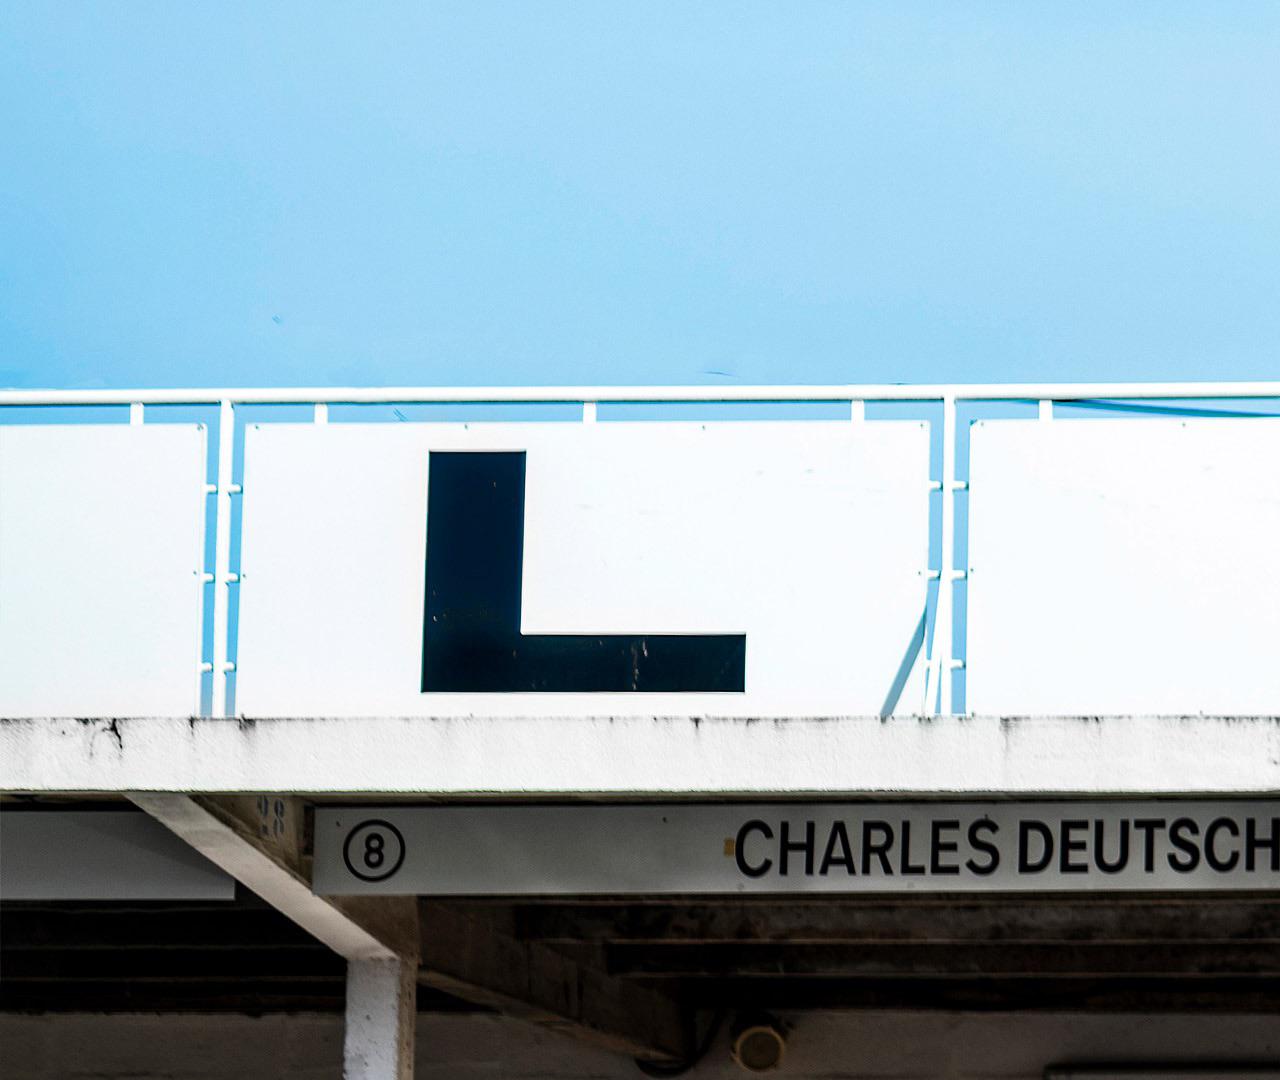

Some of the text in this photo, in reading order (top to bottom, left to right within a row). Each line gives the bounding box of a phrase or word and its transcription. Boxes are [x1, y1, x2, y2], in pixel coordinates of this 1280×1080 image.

[421, 450, 747, 693] L
[364, 831, 386, 870] 8
[734, 818, 1001, 879] CHARLES
